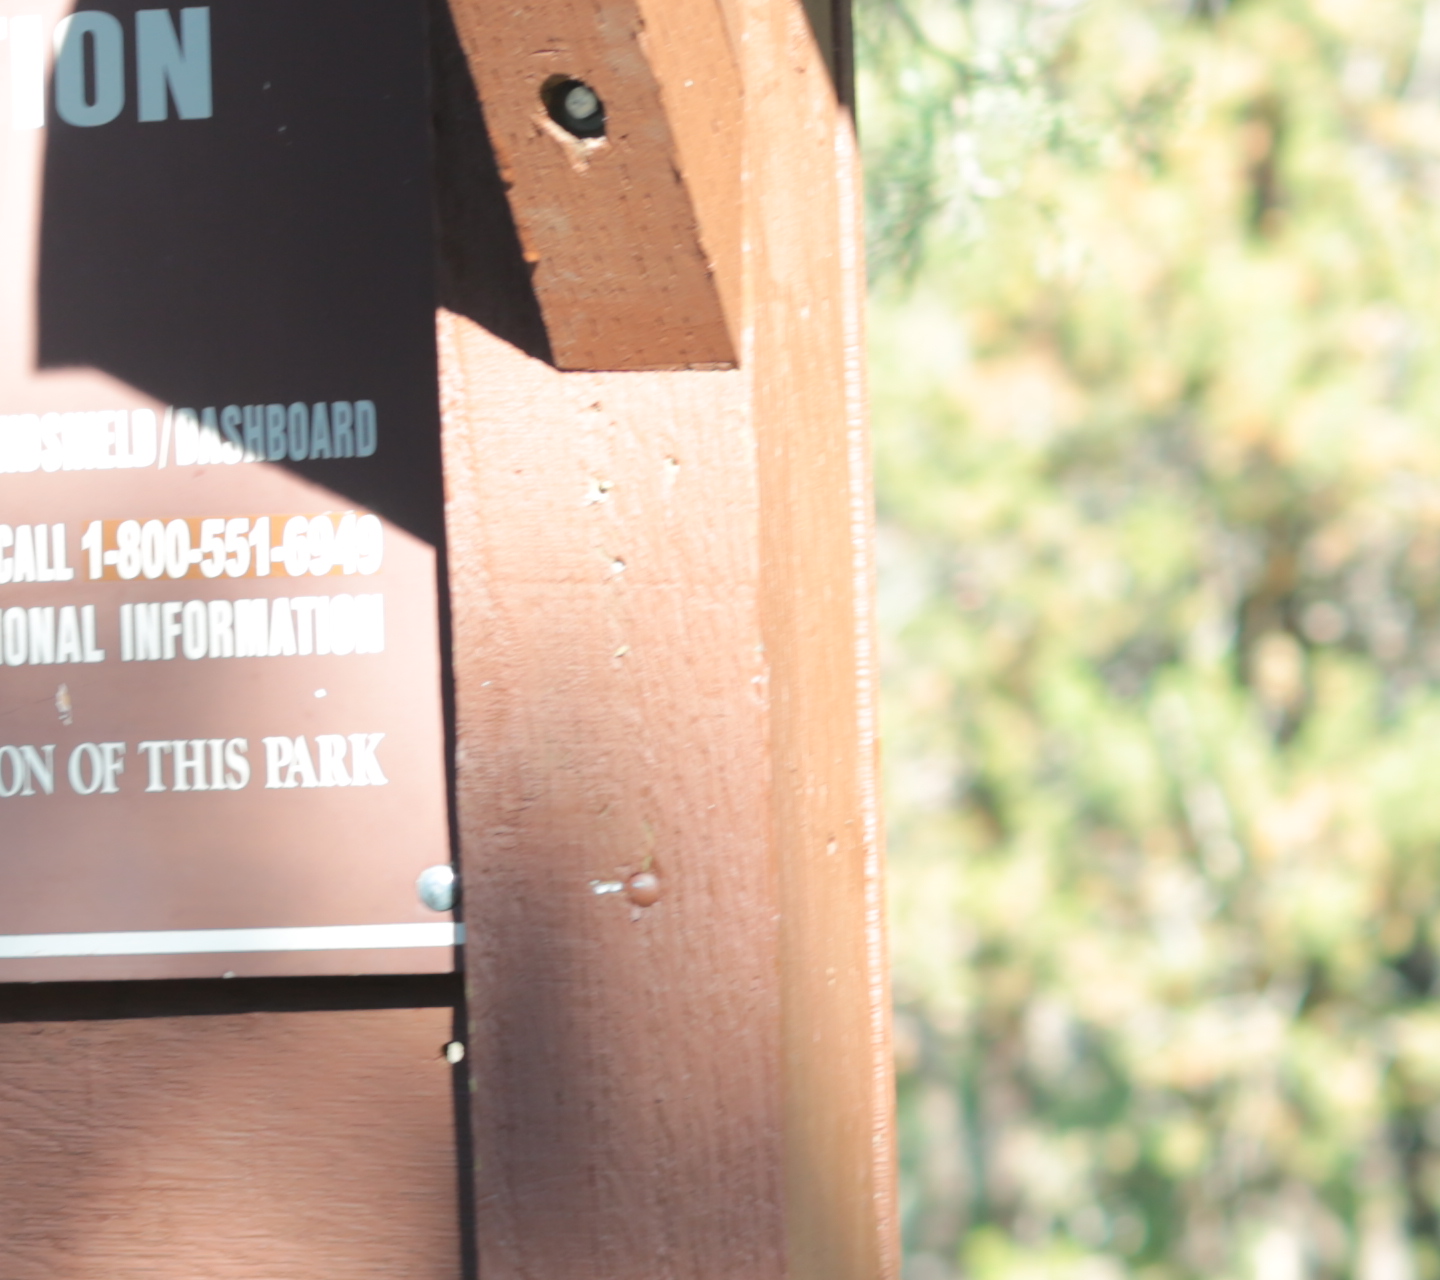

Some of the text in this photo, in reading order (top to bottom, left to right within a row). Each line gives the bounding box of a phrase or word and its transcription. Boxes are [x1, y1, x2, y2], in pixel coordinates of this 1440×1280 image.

[120, 593, 385, 662] INFORMATION
[68, 741, 127, 795] OF
[139, 737, 251, 792] THIS
[264, 732, 389, 788] PARK
